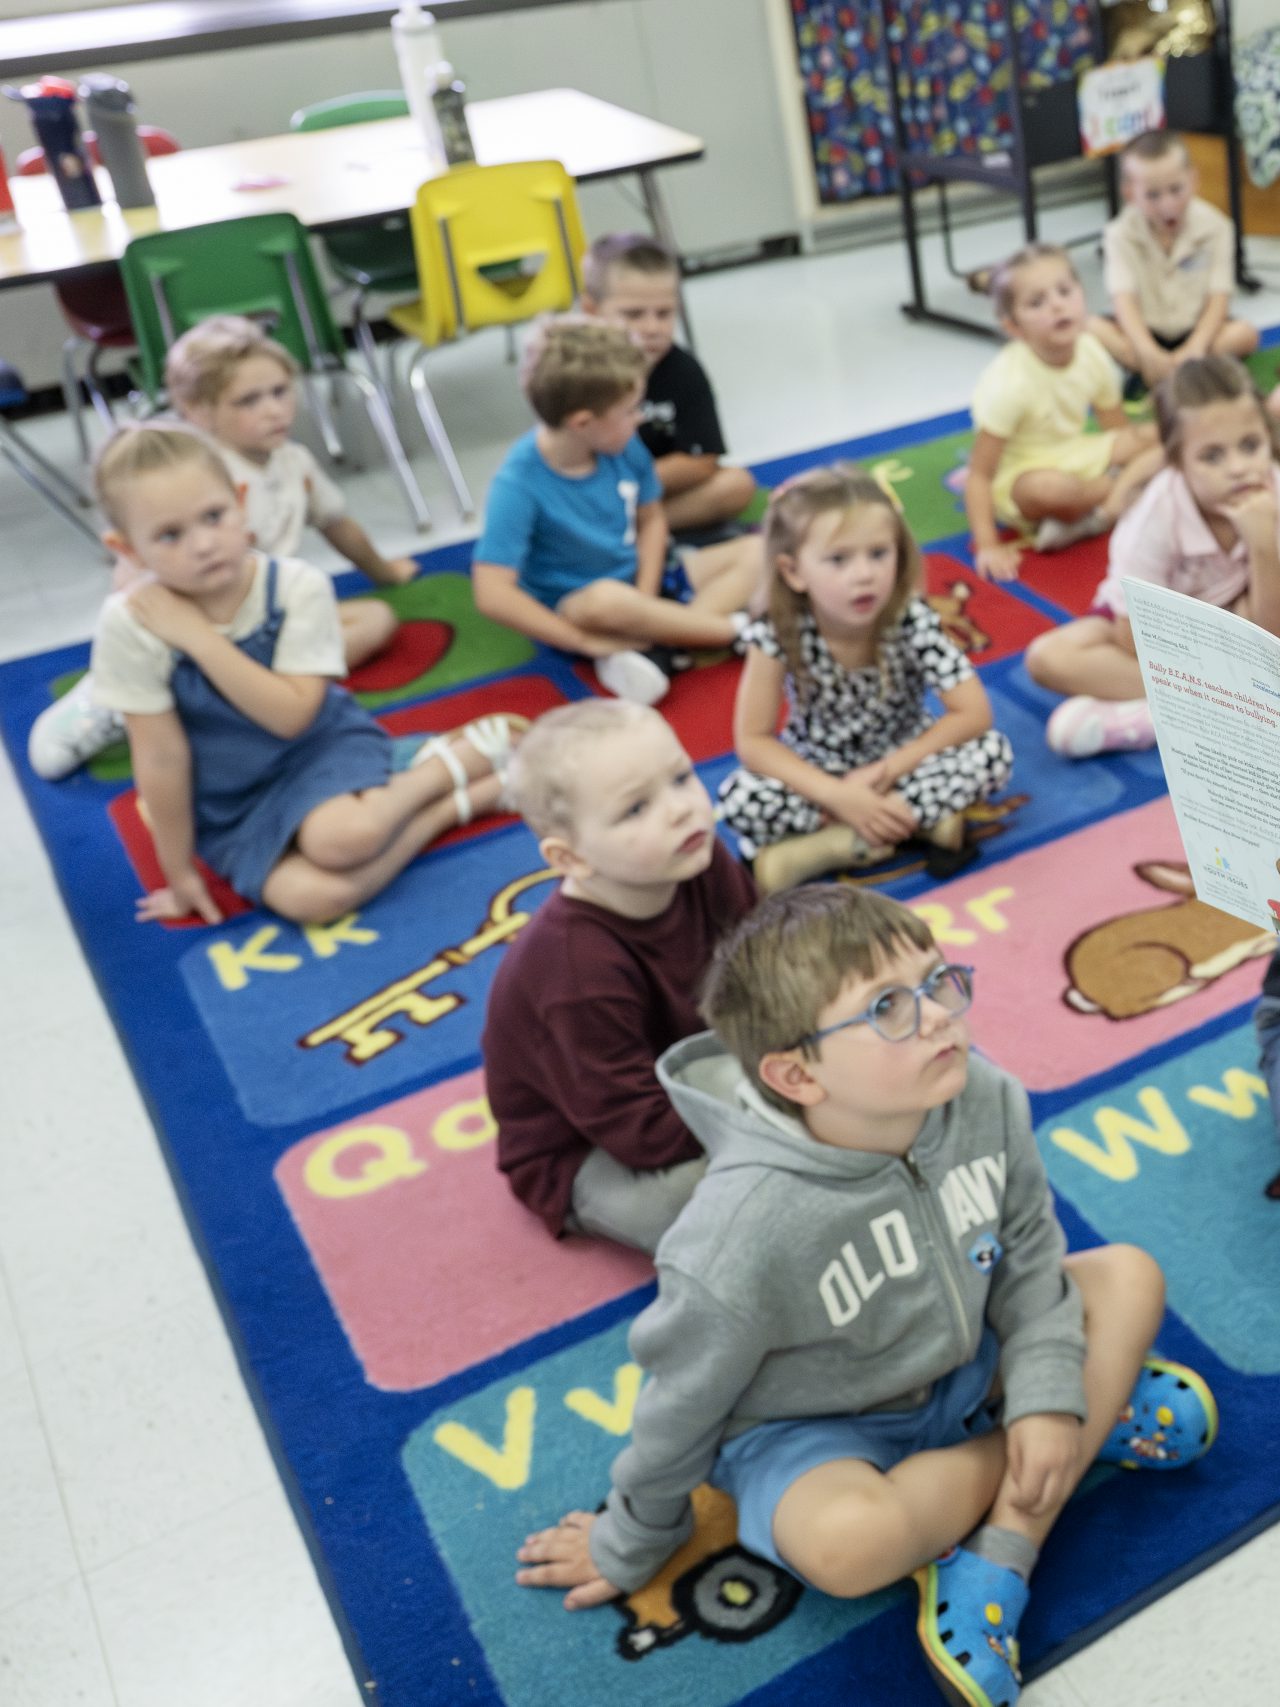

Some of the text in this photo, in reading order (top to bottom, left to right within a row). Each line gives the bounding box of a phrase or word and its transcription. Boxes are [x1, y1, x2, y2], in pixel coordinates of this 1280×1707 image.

[1149, 660, 1166, 675] Bully
[1168, 667, 1203, 687] B.E.A.N.S.
[1204, 681, 1231, 698] teaches
[1233, 692, 1265, 711] children
[1266, 704, 1280, 717] how
[1151, 675, 1278, 728] speak up when it comes to bullying.
[819, 1208, 919, 1327] OLD
